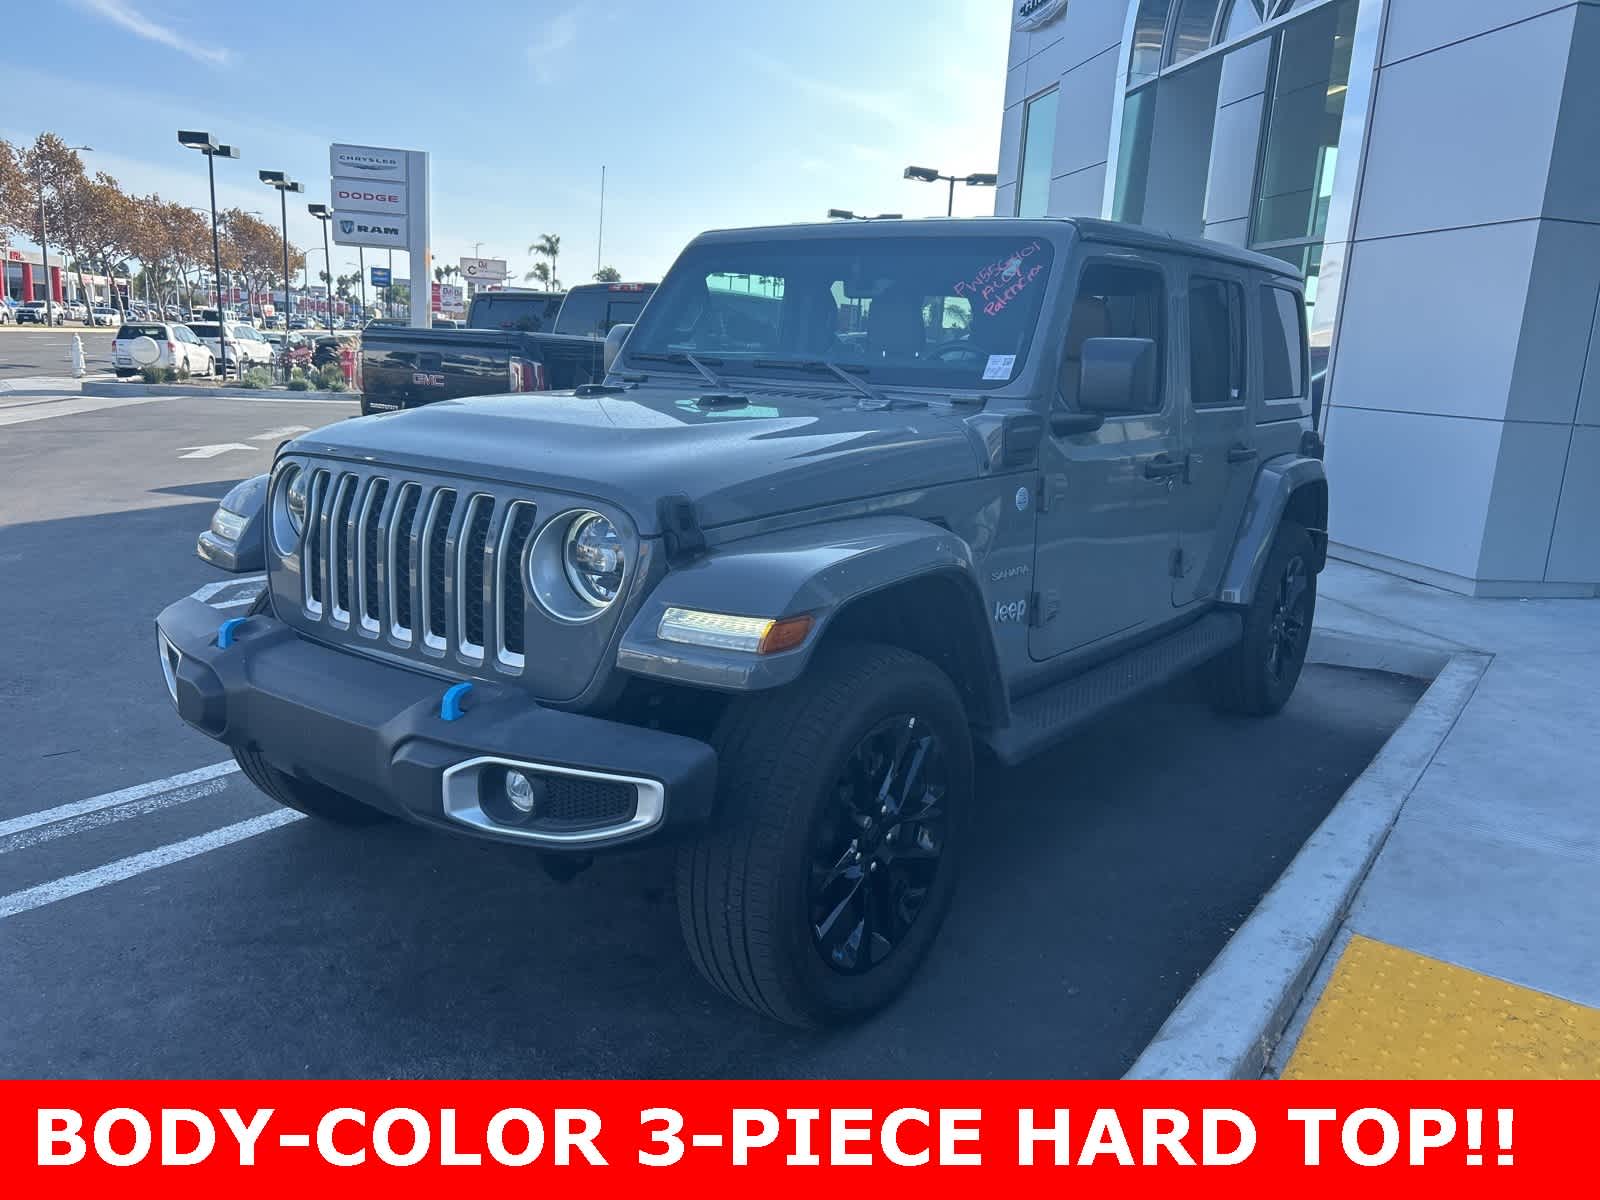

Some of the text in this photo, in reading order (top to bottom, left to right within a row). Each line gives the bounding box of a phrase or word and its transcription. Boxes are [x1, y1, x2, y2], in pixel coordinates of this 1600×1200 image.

[338, 154, 397, 165] CHRYSLER
[337, 191, 399, 203] DODGE
[357, 224, 399, 235] RAM
[412, 373, 445, 387] GMC
[994, 599, 1026, 623] Jeep
